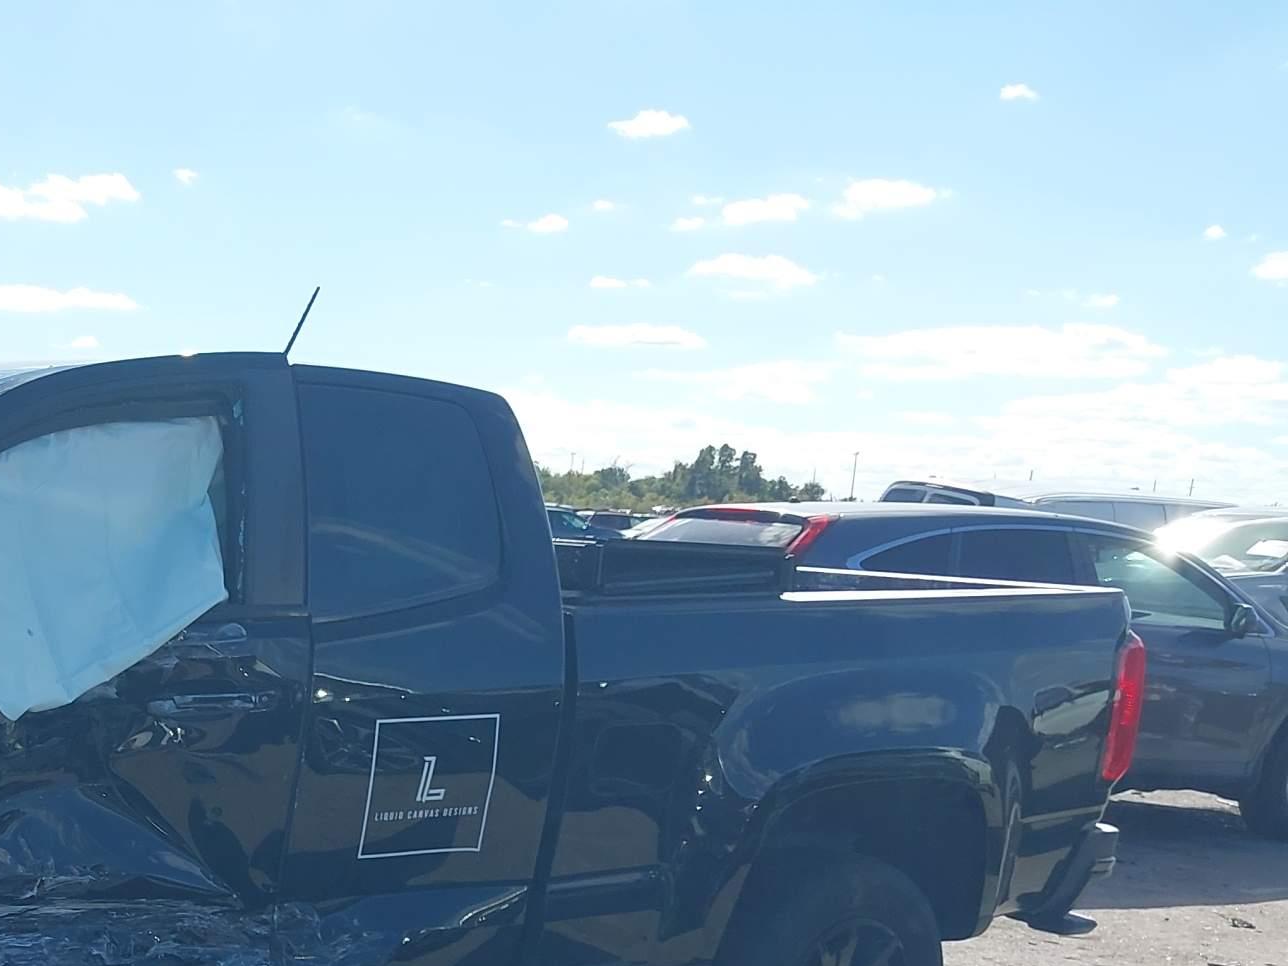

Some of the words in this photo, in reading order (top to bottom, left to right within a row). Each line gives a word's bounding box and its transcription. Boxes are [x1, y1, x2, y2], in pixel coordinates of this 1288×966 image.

[374, 811, 404, 821] LIQUID
[407, 808, 440, 820] CANVAS
[442, 806, 479, 817] DESIGNS
